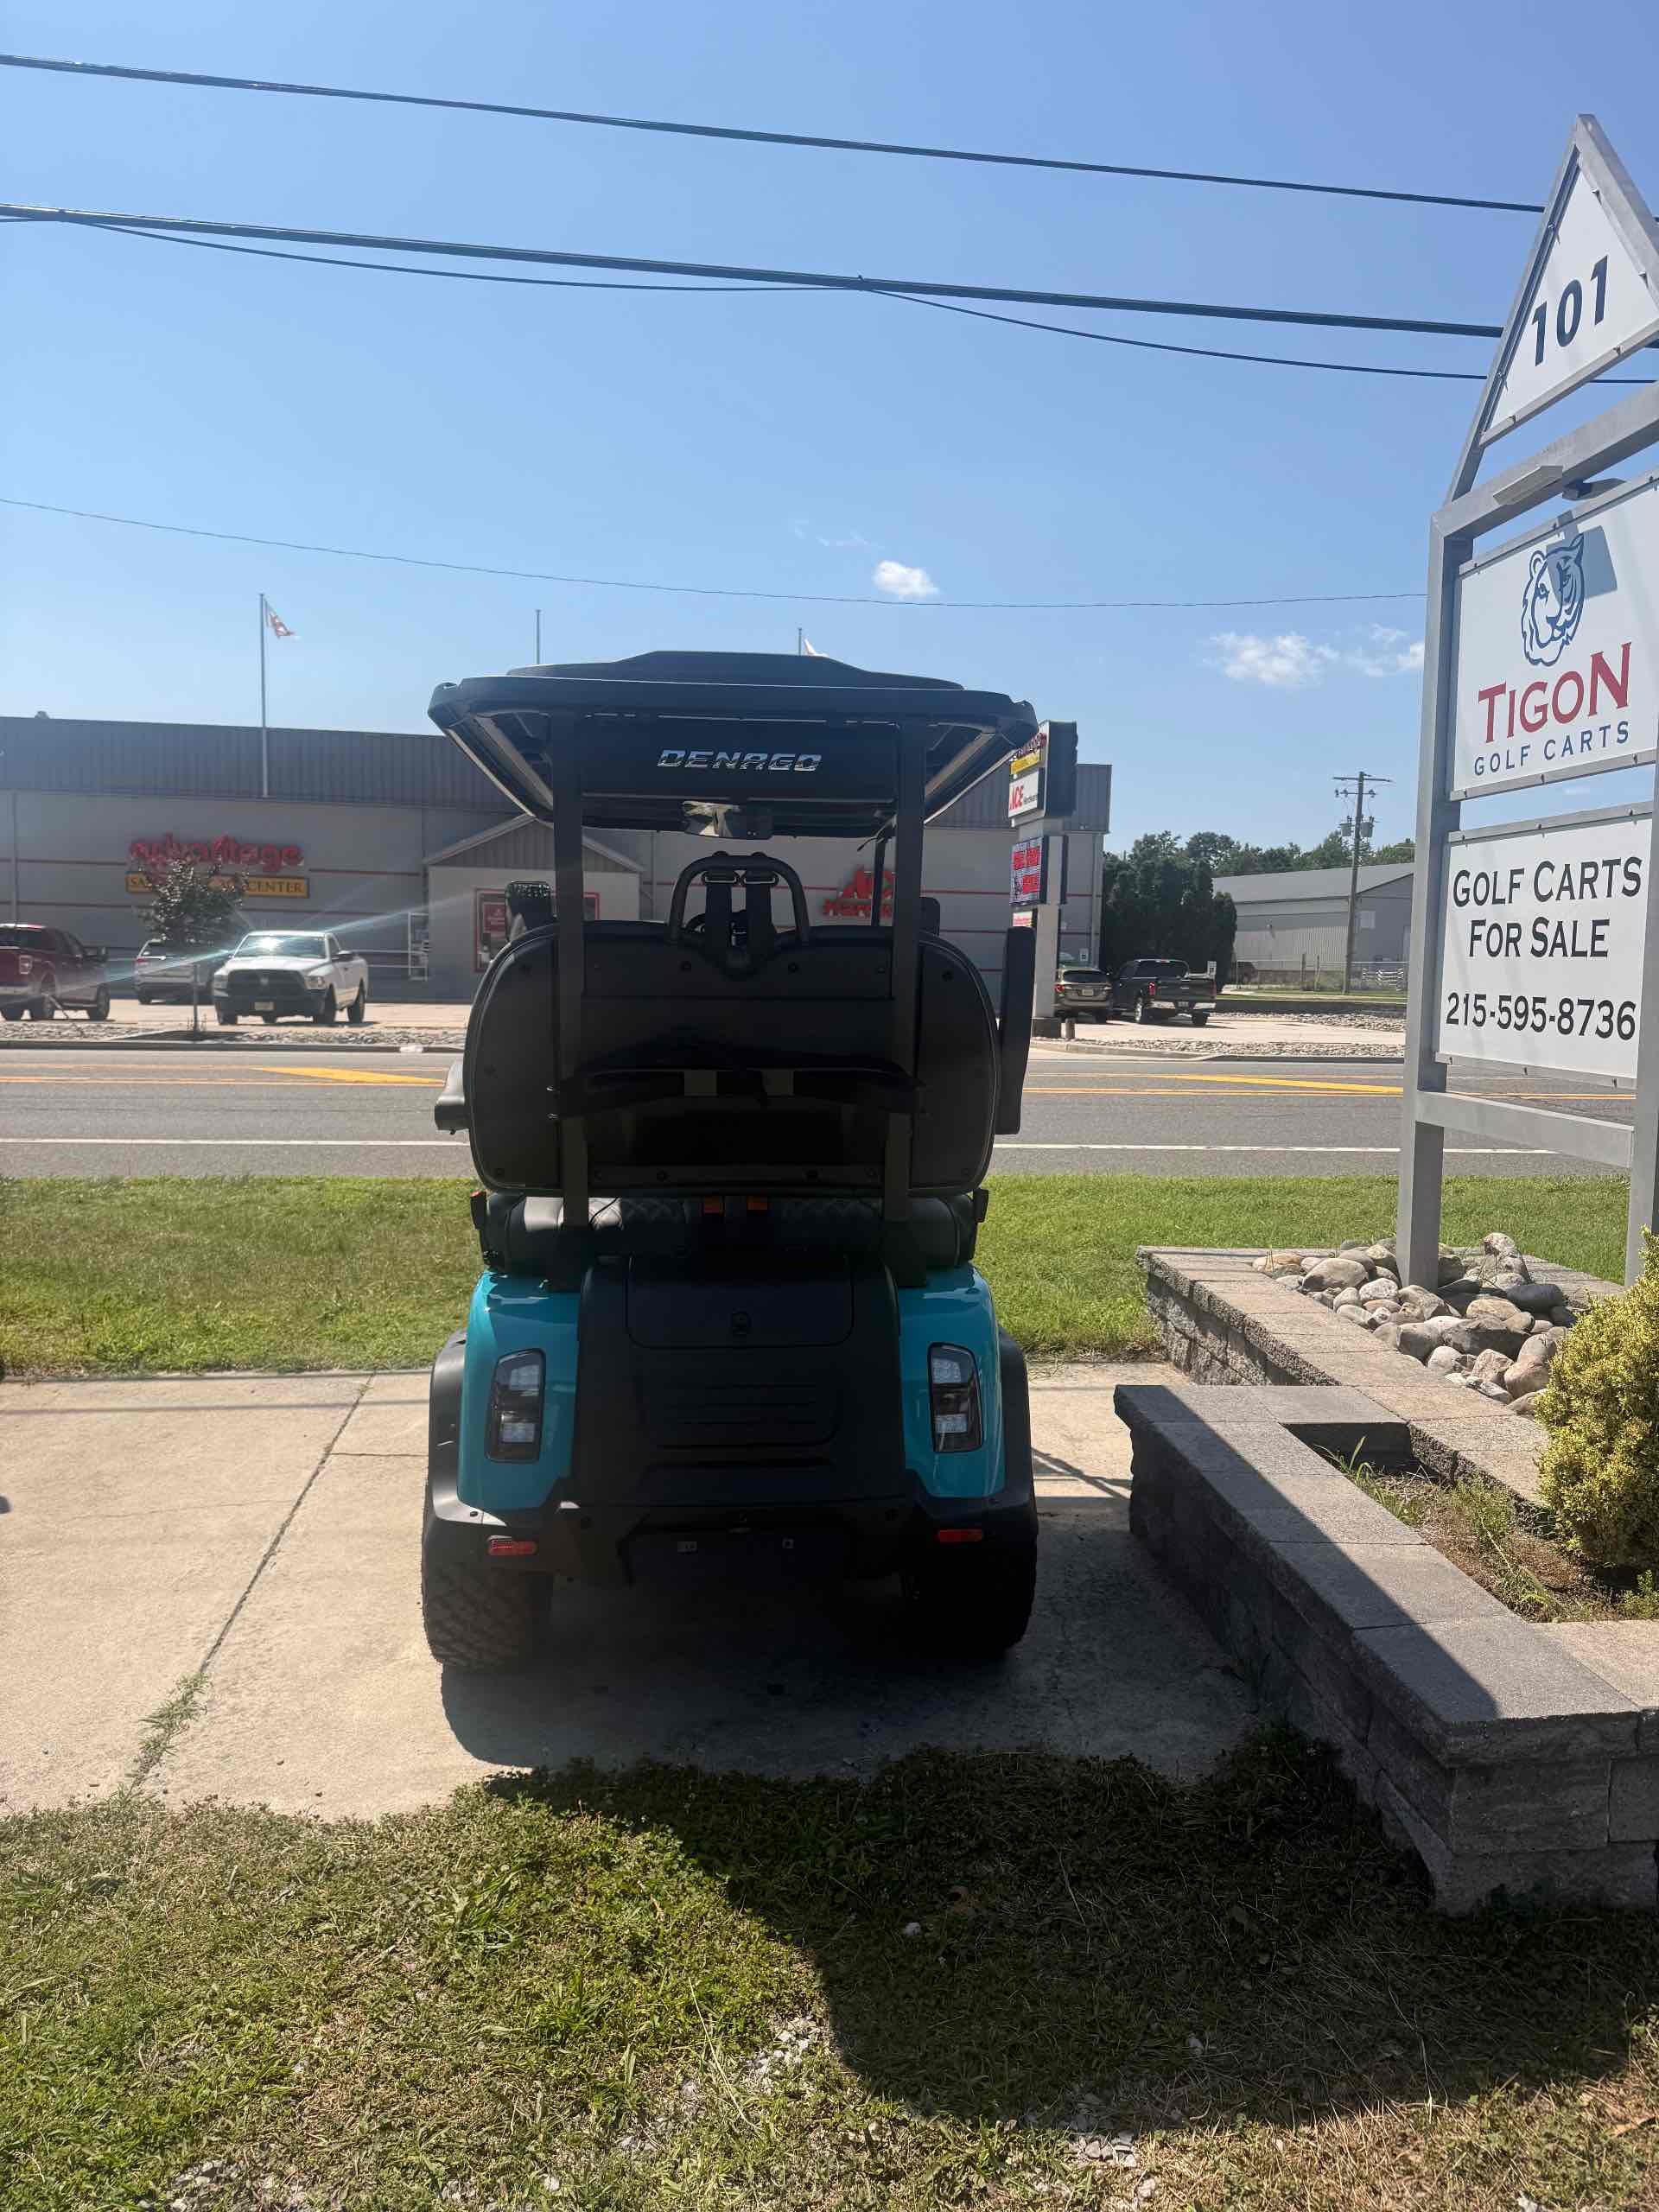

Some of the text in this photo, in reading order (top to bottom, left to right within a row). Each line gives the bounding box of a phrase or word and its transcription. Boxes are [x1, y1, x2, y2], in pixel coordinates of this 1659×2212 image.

[1531, 254, 1610, 367] 101
[657, 749, 823, 772] DENAGO
[1473, 721, 1630, 776] GOLF CARTS
[1008, 785, 1024, 810] ACE
[247, 880, 303, 893] CENTER
[1452, 856, 1643, 908] GOLF CARTS
[1469, 916, 1611, 958] FOR SALE
[1446, 991, 1637, 1042] 215-595-8736
